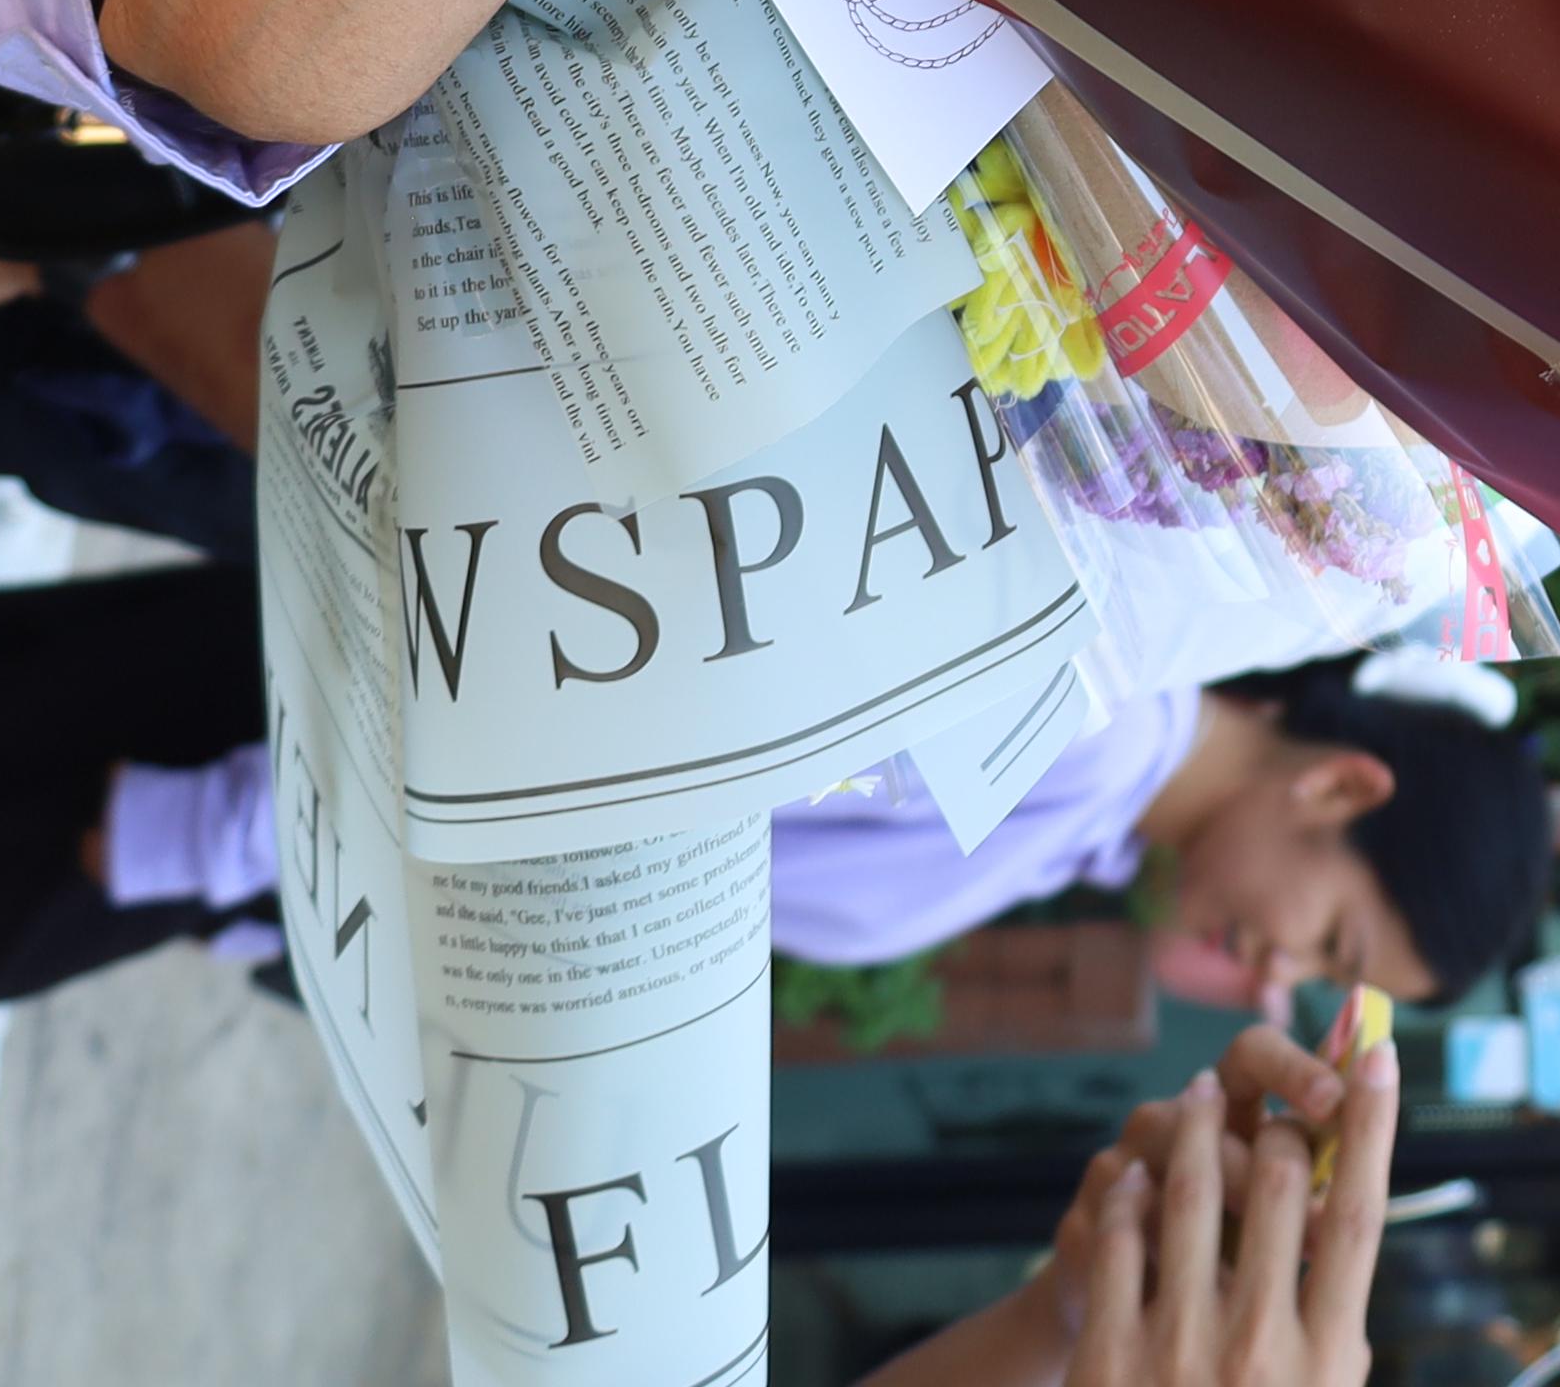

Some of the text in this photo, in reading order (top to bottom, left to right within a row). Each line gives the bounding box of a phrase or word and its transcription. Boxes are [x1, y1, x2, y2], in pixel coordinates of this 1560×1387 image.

[773, 28, 843, 180] come back they grab
[534, 63, 657, 281] avoid can keep out the
[664, 49, 782, 251] the When old and
[707, 62, 814, 267] kept you can
[549, 152, 604, 229] good book.
[865, 180, 904, 258] raise few
[420, 245, 484, 268] the chair
[474, 132, 628, 405] raising flowers for two three years
[607, 133, 728, 354] three bedrooms and two halls
[641, 141, 778, 371] are fewer and fewer such small
[671, 126, 800, 353] Maybe decades are
[461, 277, 486, 293] the
[440, 316, 460, 331] up
[465, 308, 489, 325] the
[551, 372, 582, 427] and the
[578, 363, 599, 400] long
[586, 902, 617, 924] just
[622, 892, 652, 912] met
[657, 879, 698, 904] some
[594, 865, 641, 889] asked
[646, 859, 671, 875] my
[550, 936, 590, 954] think
[595, 929, 626, 947] that
[643, 917, 671, 934] can
[517, 973, 542, 984] one
[547, 969, 562, 983] in
[565, 960, 591, 981] the
[519, 1003, 547, 1014] was
[550, 989, 613, 1013] worried
